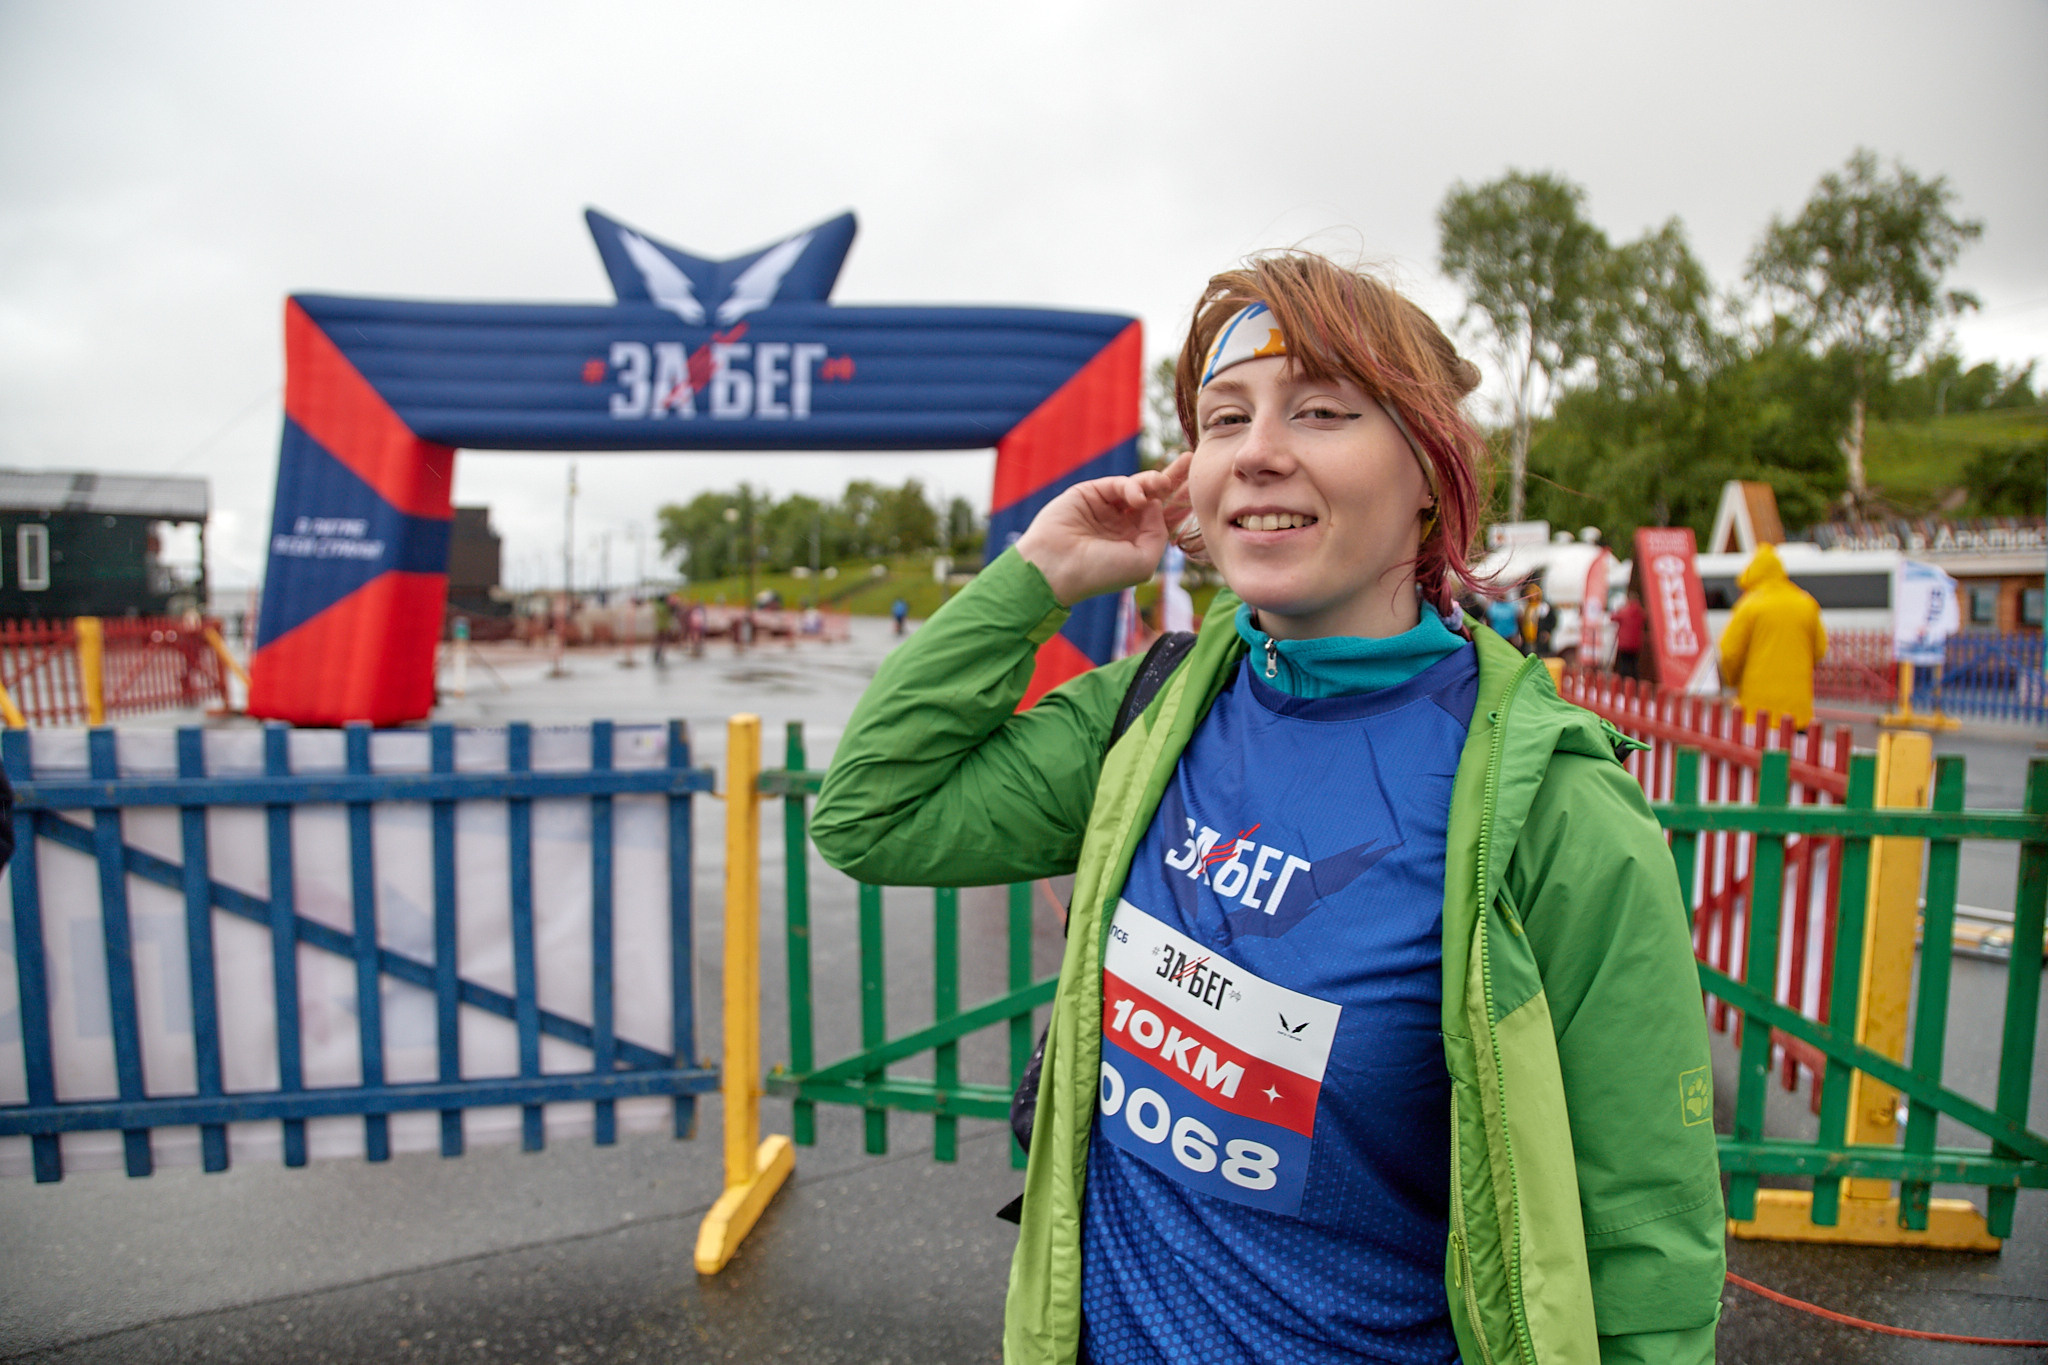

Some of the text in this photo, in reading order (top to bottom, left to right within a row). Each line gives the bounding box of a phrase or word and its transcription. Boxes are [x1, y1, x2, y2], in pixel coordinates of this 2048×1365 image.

[1165, 817, 1312, 916] ЗАБЕГ
[1111, 998, 1246, 1099] 10КМ
[1101, 1060, 1280, 1191] 0068
